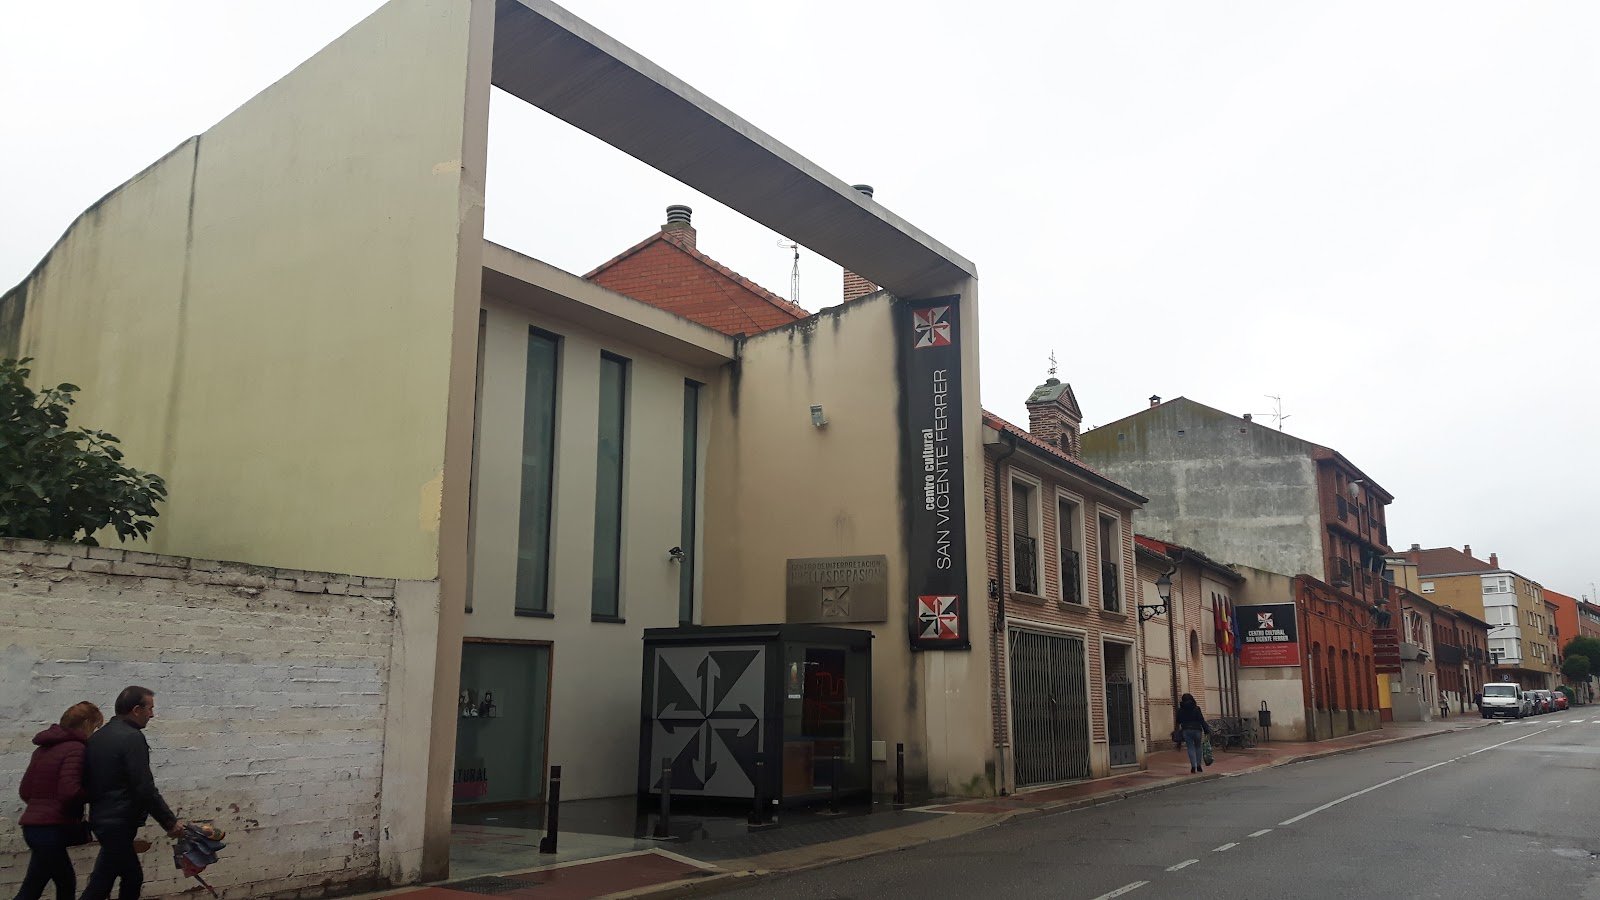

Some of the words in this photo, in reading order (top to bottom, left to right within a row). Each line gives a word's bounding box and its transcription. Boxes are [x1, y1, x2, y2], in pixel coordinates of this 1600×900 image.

[934, 370, 948, 442] FERRER
[922, 429, 934, 472] cultural
[924, 474, 934, 511] centro
[936, 446, 950, 526] VICENTE
[936, 530, 952, 570] SAN
